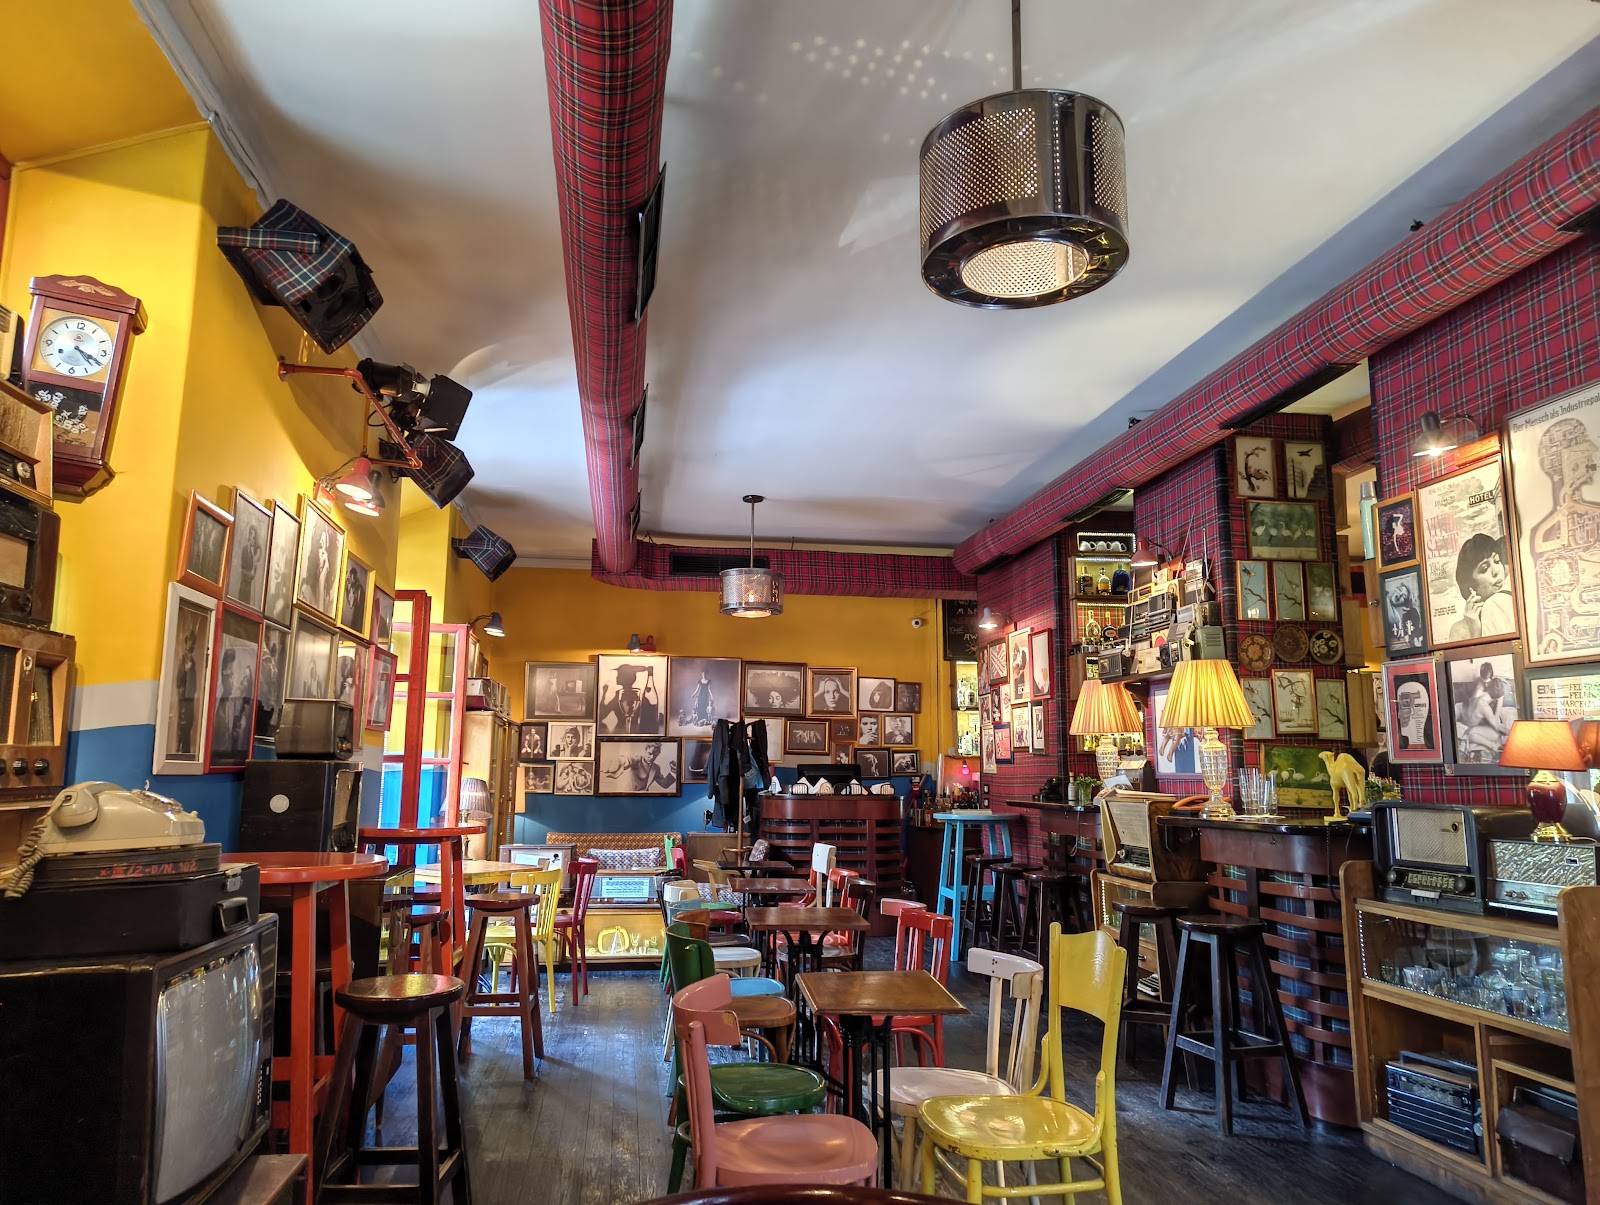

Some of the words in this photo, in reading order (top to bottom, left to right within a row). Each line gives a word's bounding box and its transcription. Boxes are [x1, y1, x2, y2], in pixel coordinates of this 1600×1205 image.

[76, 322, 86, 331] 12
[45, 339, 53, 347] 9
[100, 349, 107, 357] 3
[68, 366, 76, 375] 6
[1512, 423, 1524, 433] Der
[1524, 411, 1549, 428] Mensch
[1549, 408, 1559, 420] als
[1469, 490, 1494, 505] HOTEL
